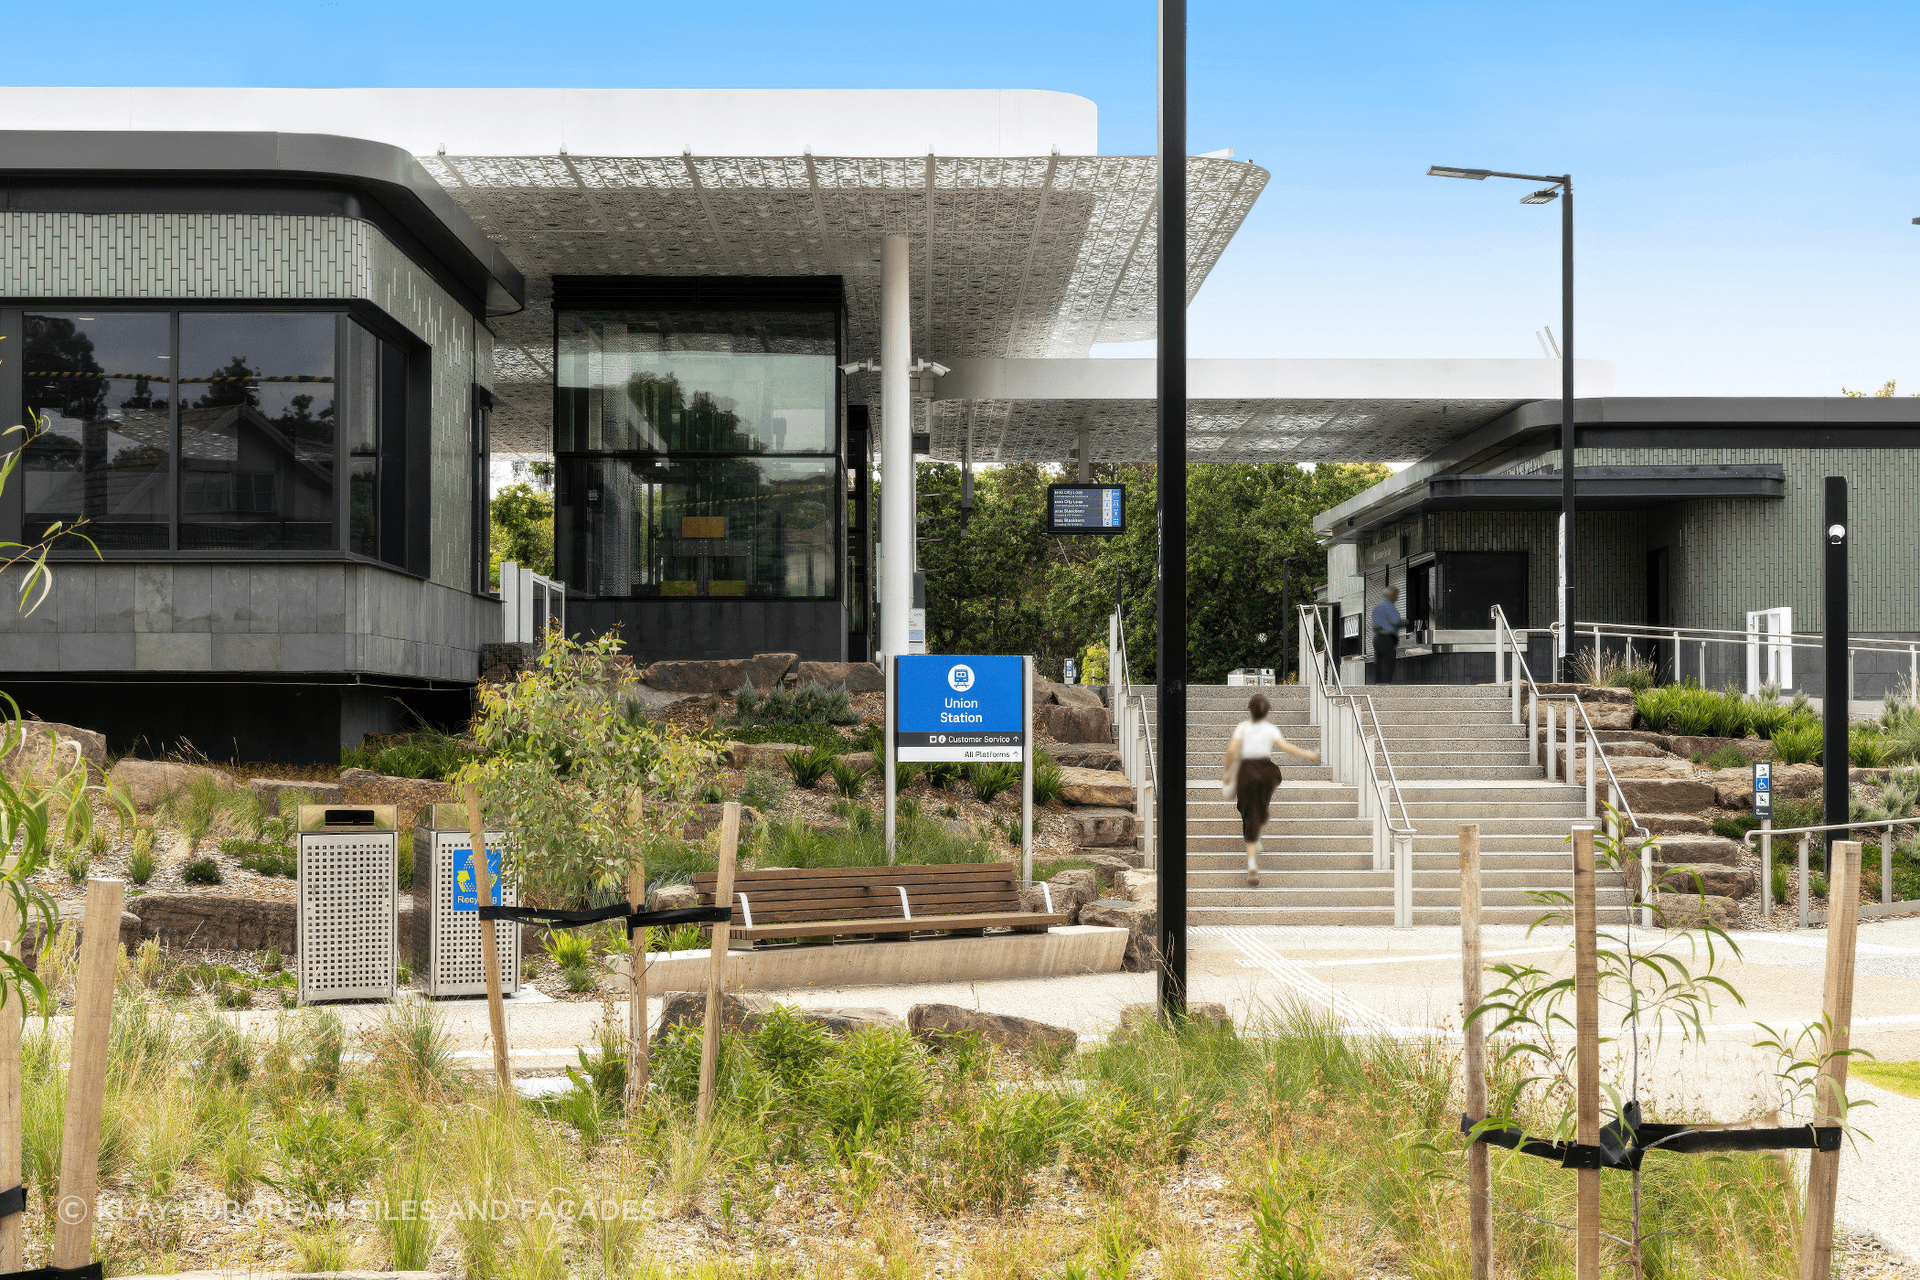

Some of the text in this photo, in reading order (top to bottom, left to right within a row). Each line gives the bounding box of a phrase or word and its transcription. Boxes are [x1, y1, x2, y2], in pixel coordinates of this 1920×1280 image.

[944, 697, 978, 709] Union
[940, 712, 983, 723] Station
[948, 735, 1010, 744] Customer Service
[975, 750, 1010, 758] Platforms
[457, 896, 497, 904] Recyg
